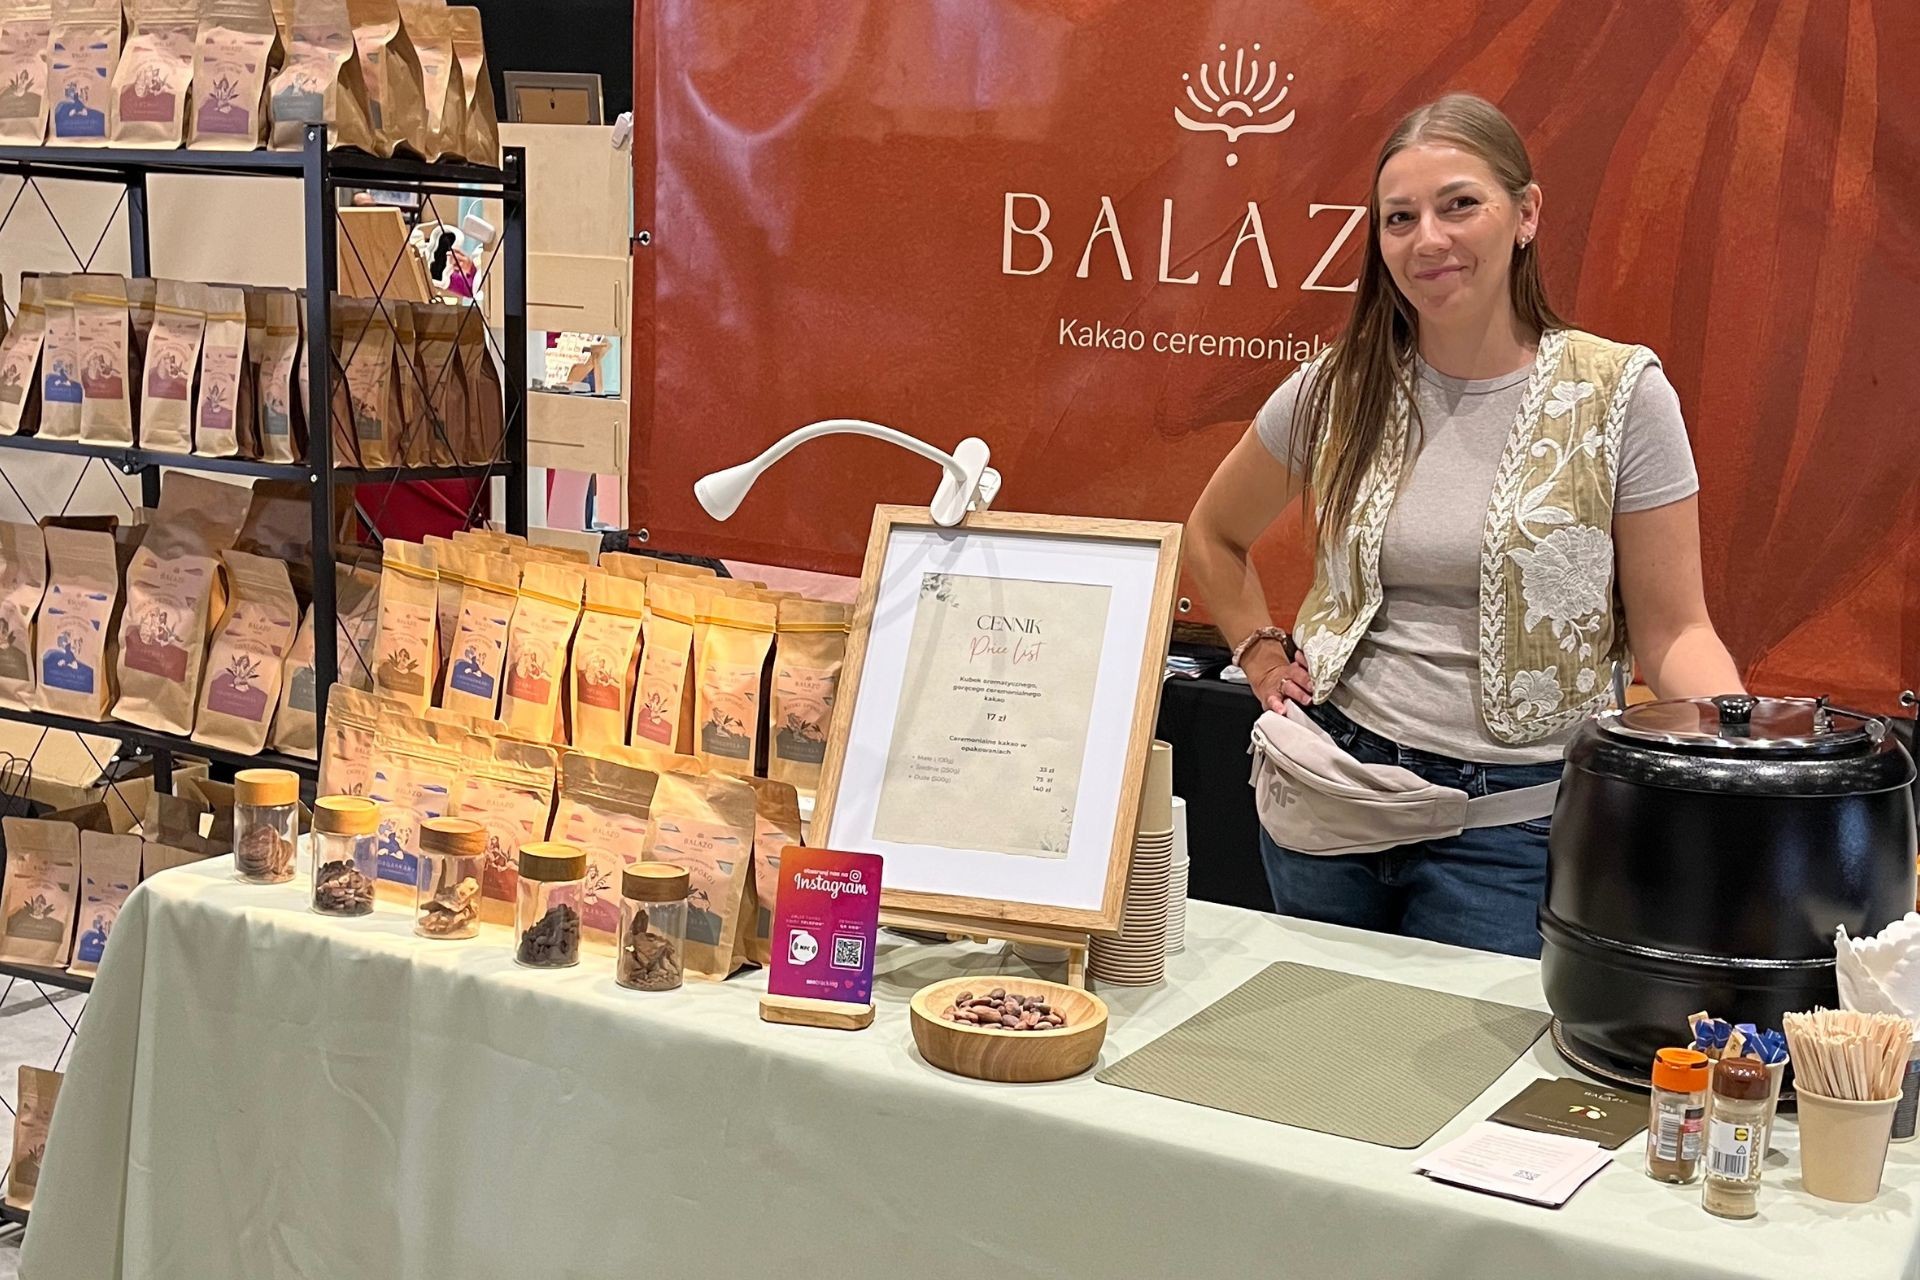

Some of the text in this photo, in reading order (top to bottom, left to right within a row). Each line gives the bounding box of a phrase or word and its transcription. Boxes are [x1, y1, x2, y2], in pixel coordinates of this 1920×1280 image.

[1001, 192, 1368, 292] BALAZ
[1058, 318, 1145, 351] Kakao
[976, 614, 1044, 634] CENNIK
[969, 635, 1008, 664] Price
[983, 695, 1006, 703] kakao
[986, 712, 997, 721] 17
[997, 740, 1019, 748] kakao
[683, 838, 714, 850] BALAZO
[793, 872, 869, 899] Instagram
